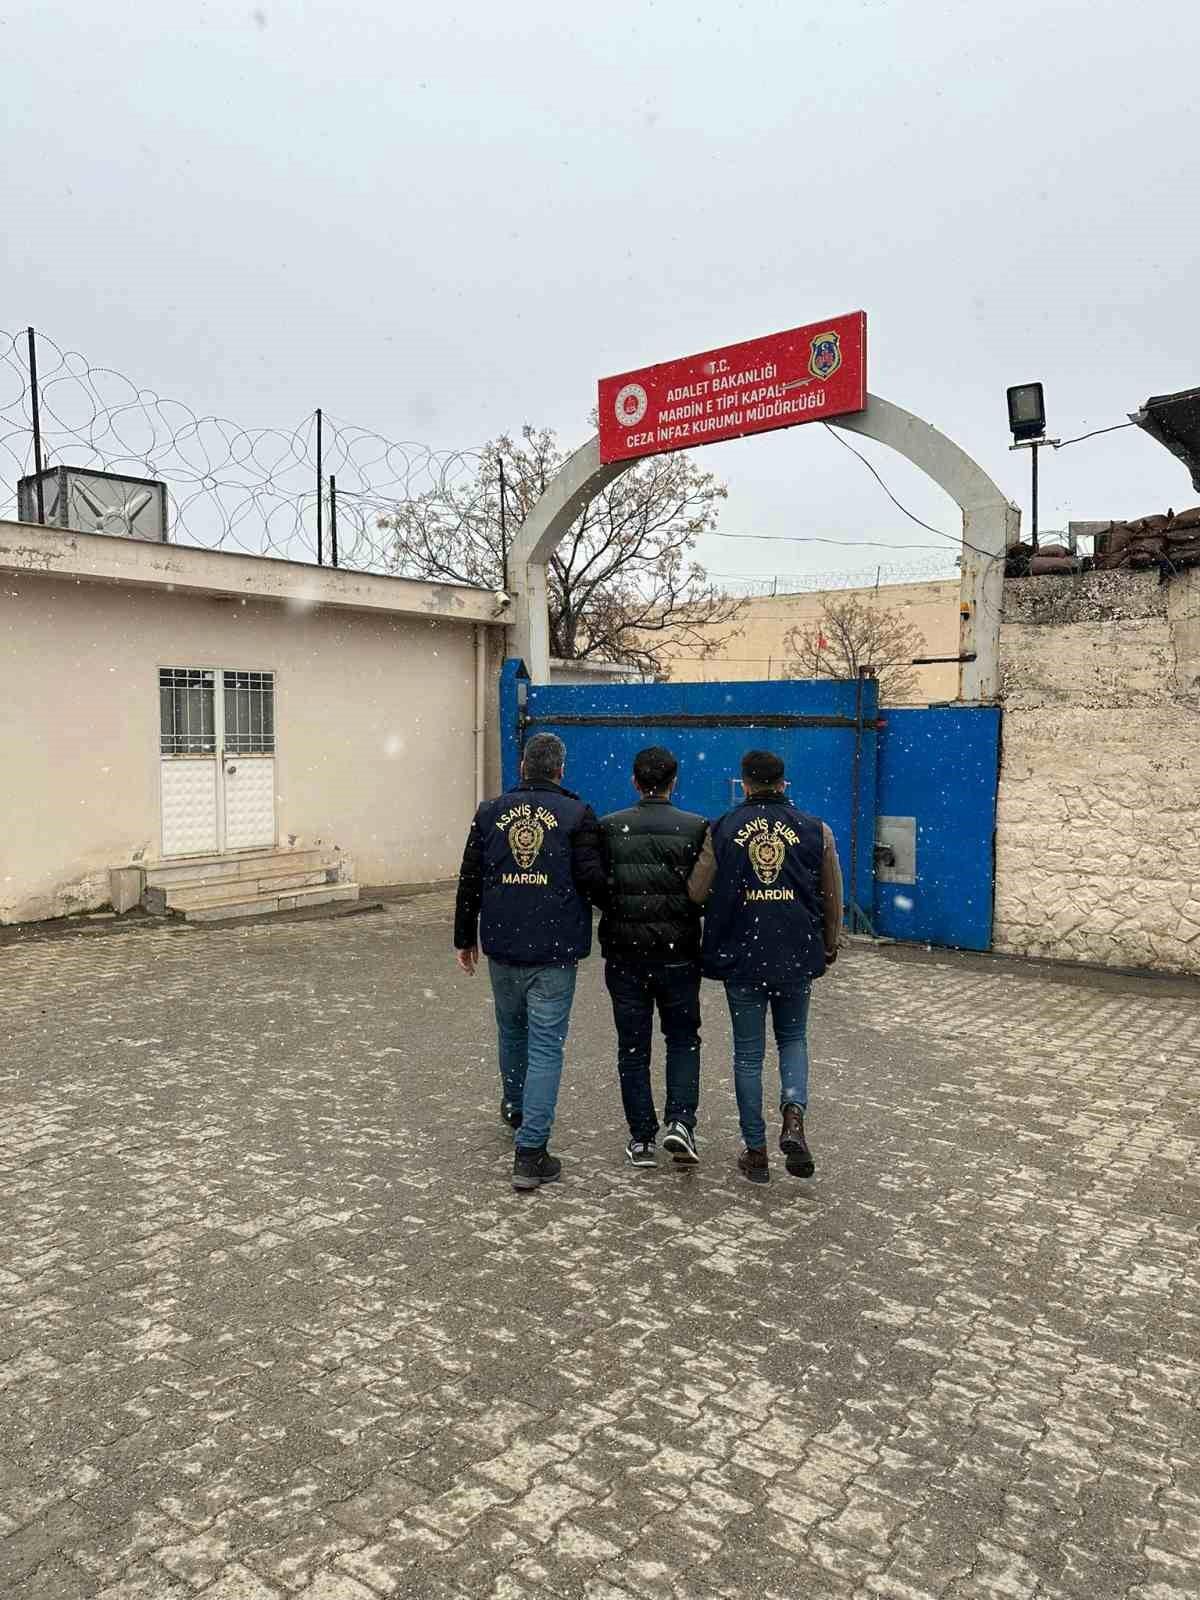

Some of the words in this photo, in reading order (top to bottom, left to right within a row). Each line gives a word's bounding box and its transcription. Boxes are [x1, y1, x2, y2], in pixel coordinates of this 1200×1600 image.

[709, 359, 730, 375] T.C.
[667, 383, 709, 402] ADALET
[712, 363, 777, 392] BAKANLIĞI
[658, 403, 703, 424] MARDİN
[706, 401, 713, 413] E
[716, 393, 738, 411] TİPİ
[741, 382, 786, 404] KAPALI
[626, 431, 654, 448] CEZA
[657, 424, 690, 443] İNFAZ
[692, 410, 743, 434] KURUMU
[746, 389, 826, 422] MÜDÜRLÜĞÜ
[502, 871, 548, 885] MARDİN
[745, 886, 794, 900] MARDİN
